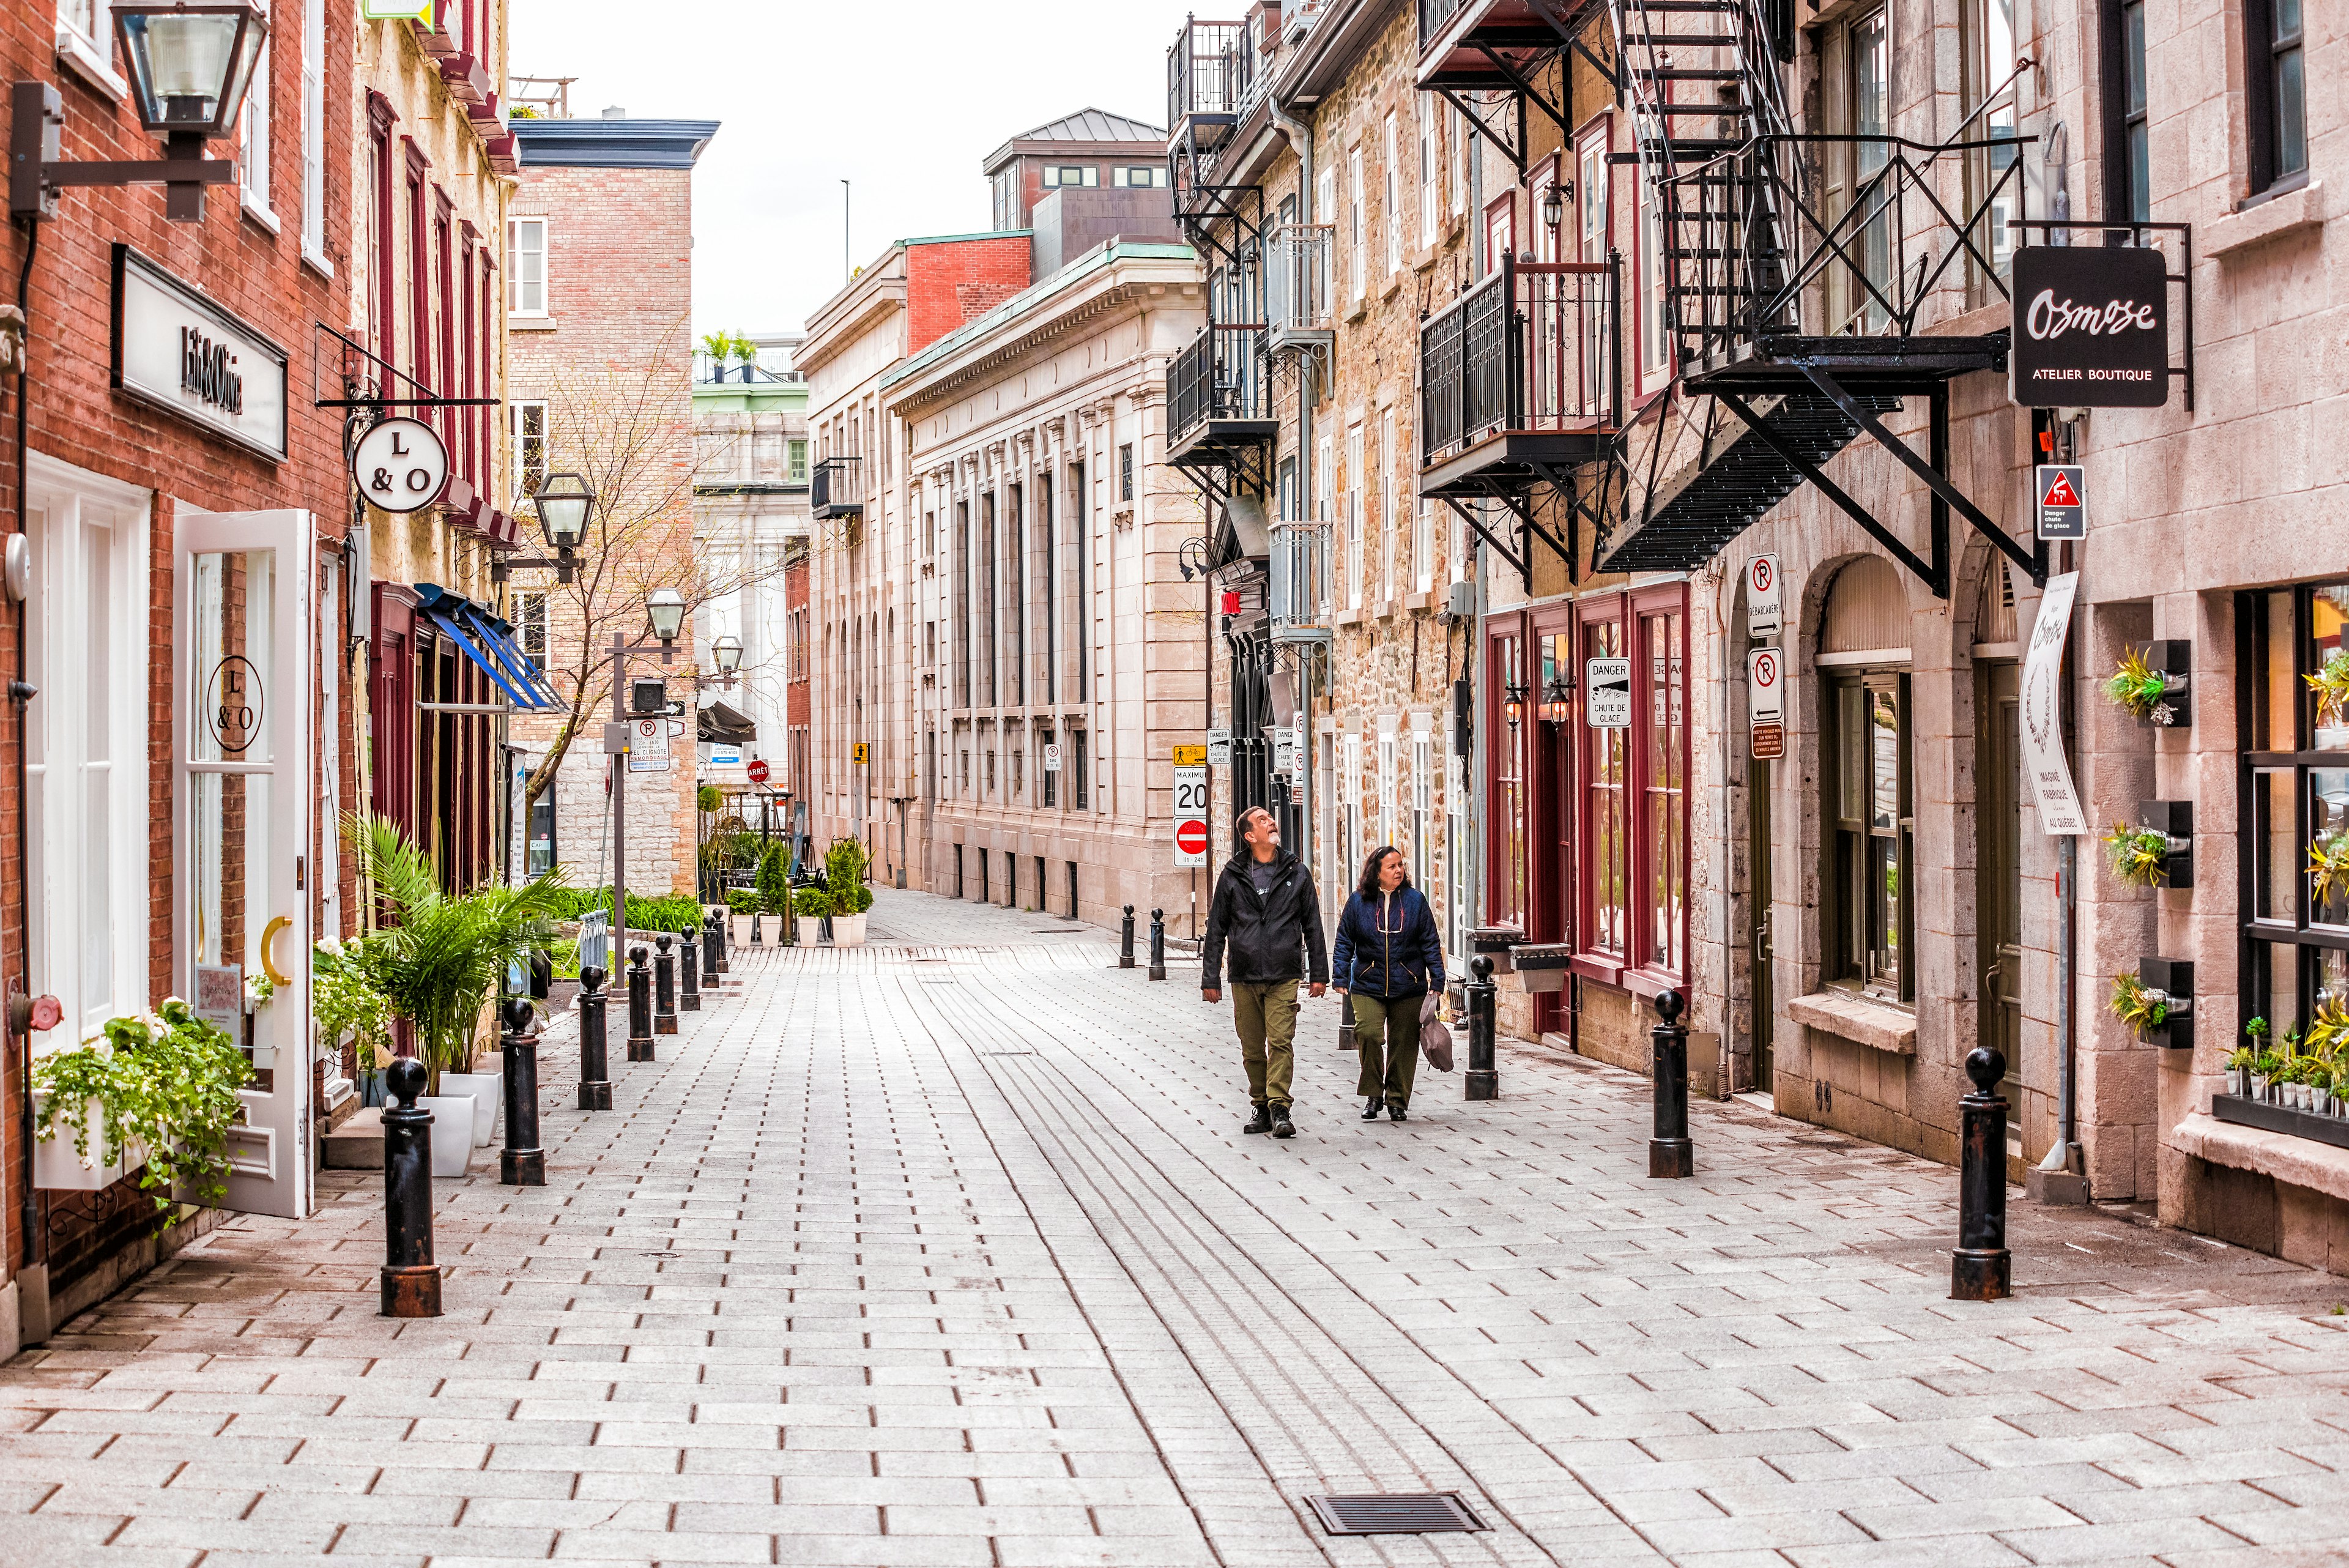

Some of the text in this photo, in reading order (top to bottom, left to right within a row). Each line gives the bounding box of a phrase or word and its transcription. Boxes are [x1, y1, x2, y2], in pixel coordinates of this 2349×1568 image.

[2027, 288, 2156, 340] Osmose
[2032, 369, 2152, 381] ATELIER BOUTIQUE
[392, 432, 409, 455] L
[371, 467, 431, 492] & O
[1750, 603, 1779, 616] DÉBARCADÈRE
[1593, 665, 1626, 675] DANGER
[229, 671, 241, 693] L
[217, 705, 253, 730] & O
[749, 766, 768, 776] ARRÊT
[2039, 769, 2060, 782] IMAGINÉ
[1178, 784, 1206, 809] 20
[2043, 787, 2068, 800] FABRIQUÉ
[2049, 815, 2077, 828] AU QUÉBEC
